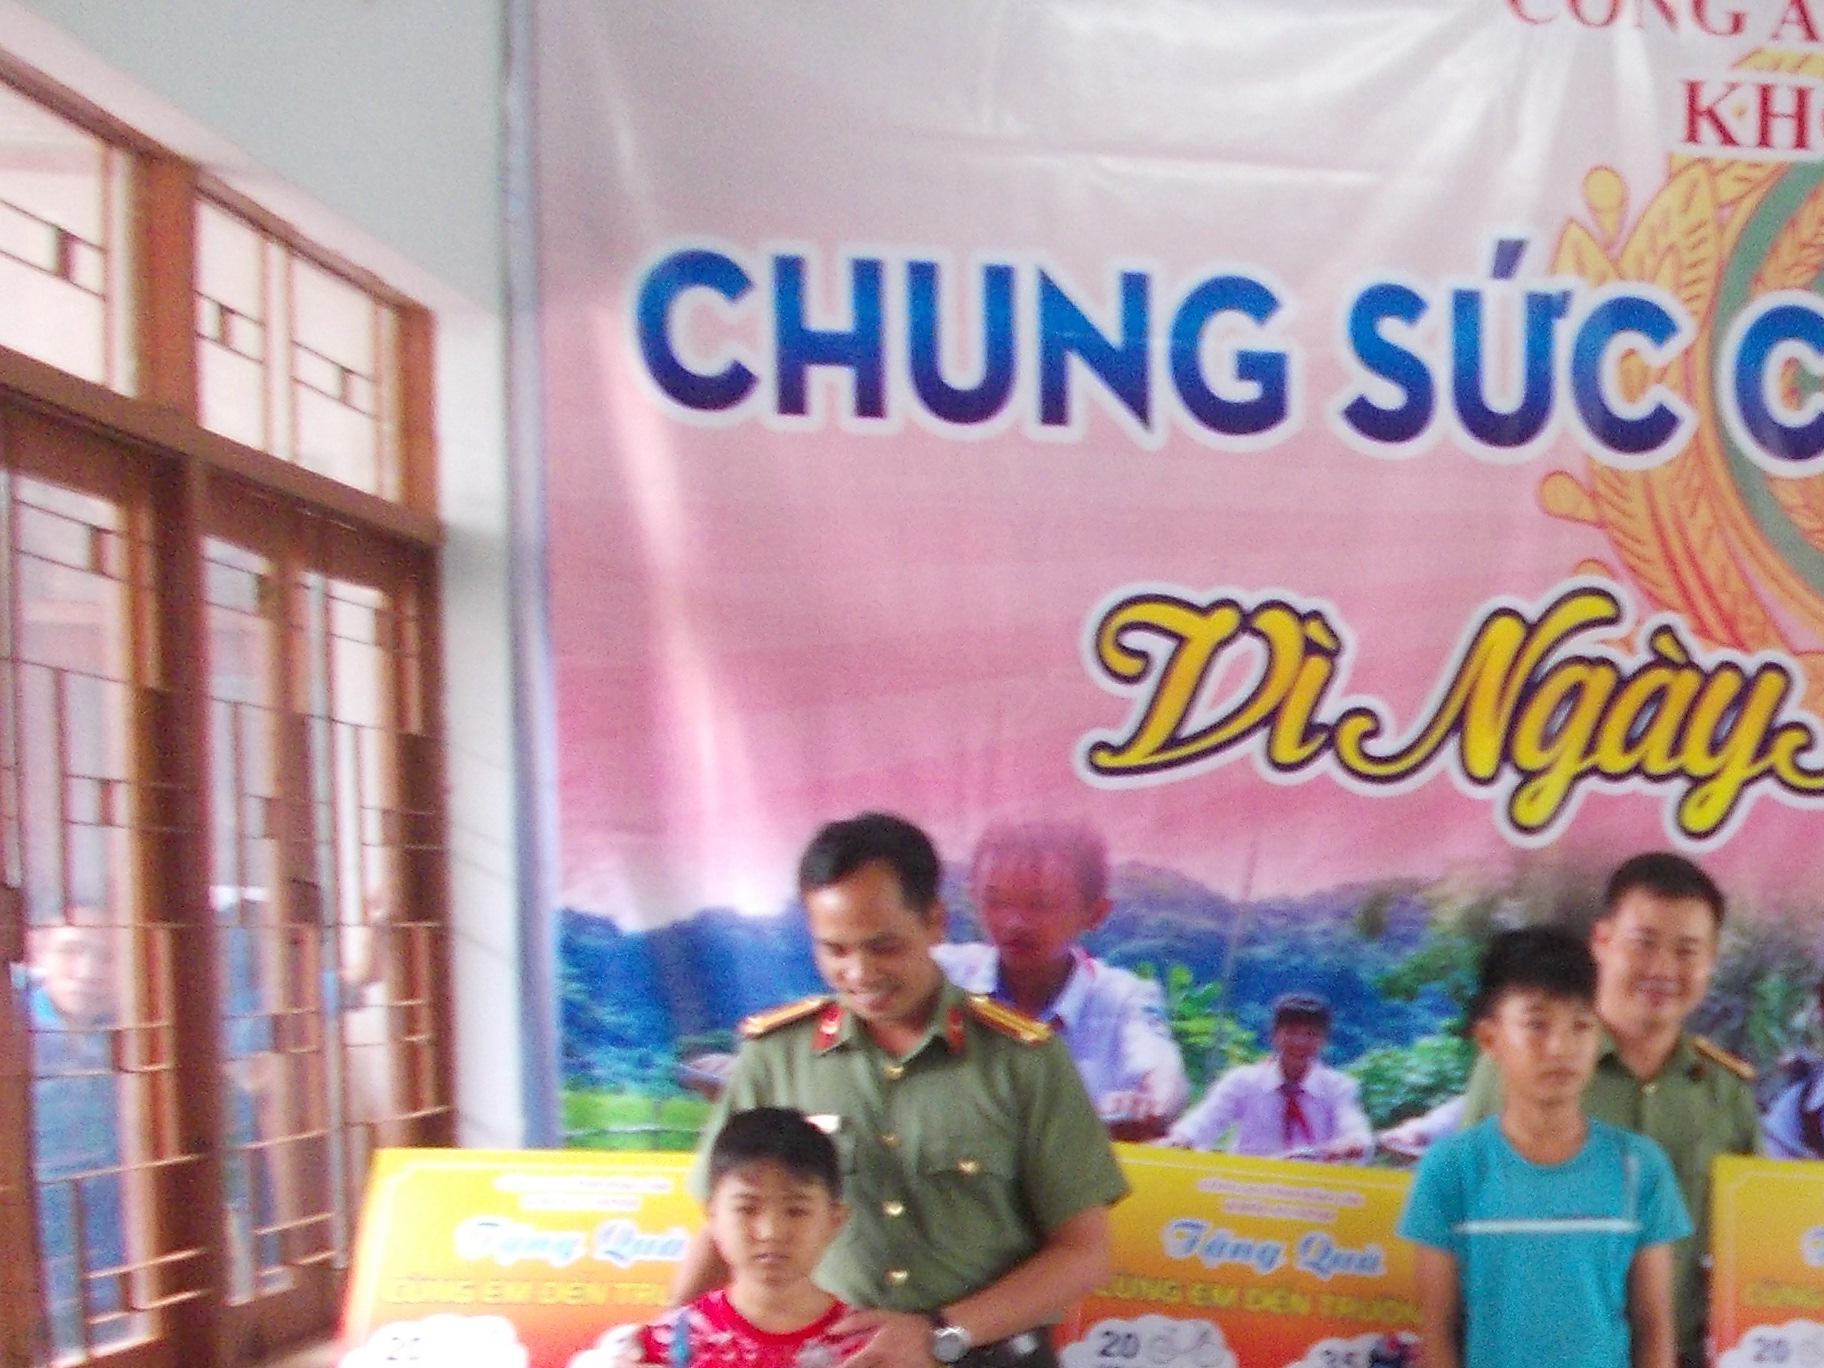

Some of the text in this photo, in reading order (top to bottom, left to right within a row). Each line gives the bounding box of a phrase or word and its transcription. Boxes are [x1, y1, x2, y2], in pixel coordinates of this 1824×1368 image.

[636, 249, 1290, 437] CHUNG
[1343, 240, 1687, 454] SỨC
[1334, 586, 1794, 840] Ngày
[1098, 1329, 1142, 1360] 20
